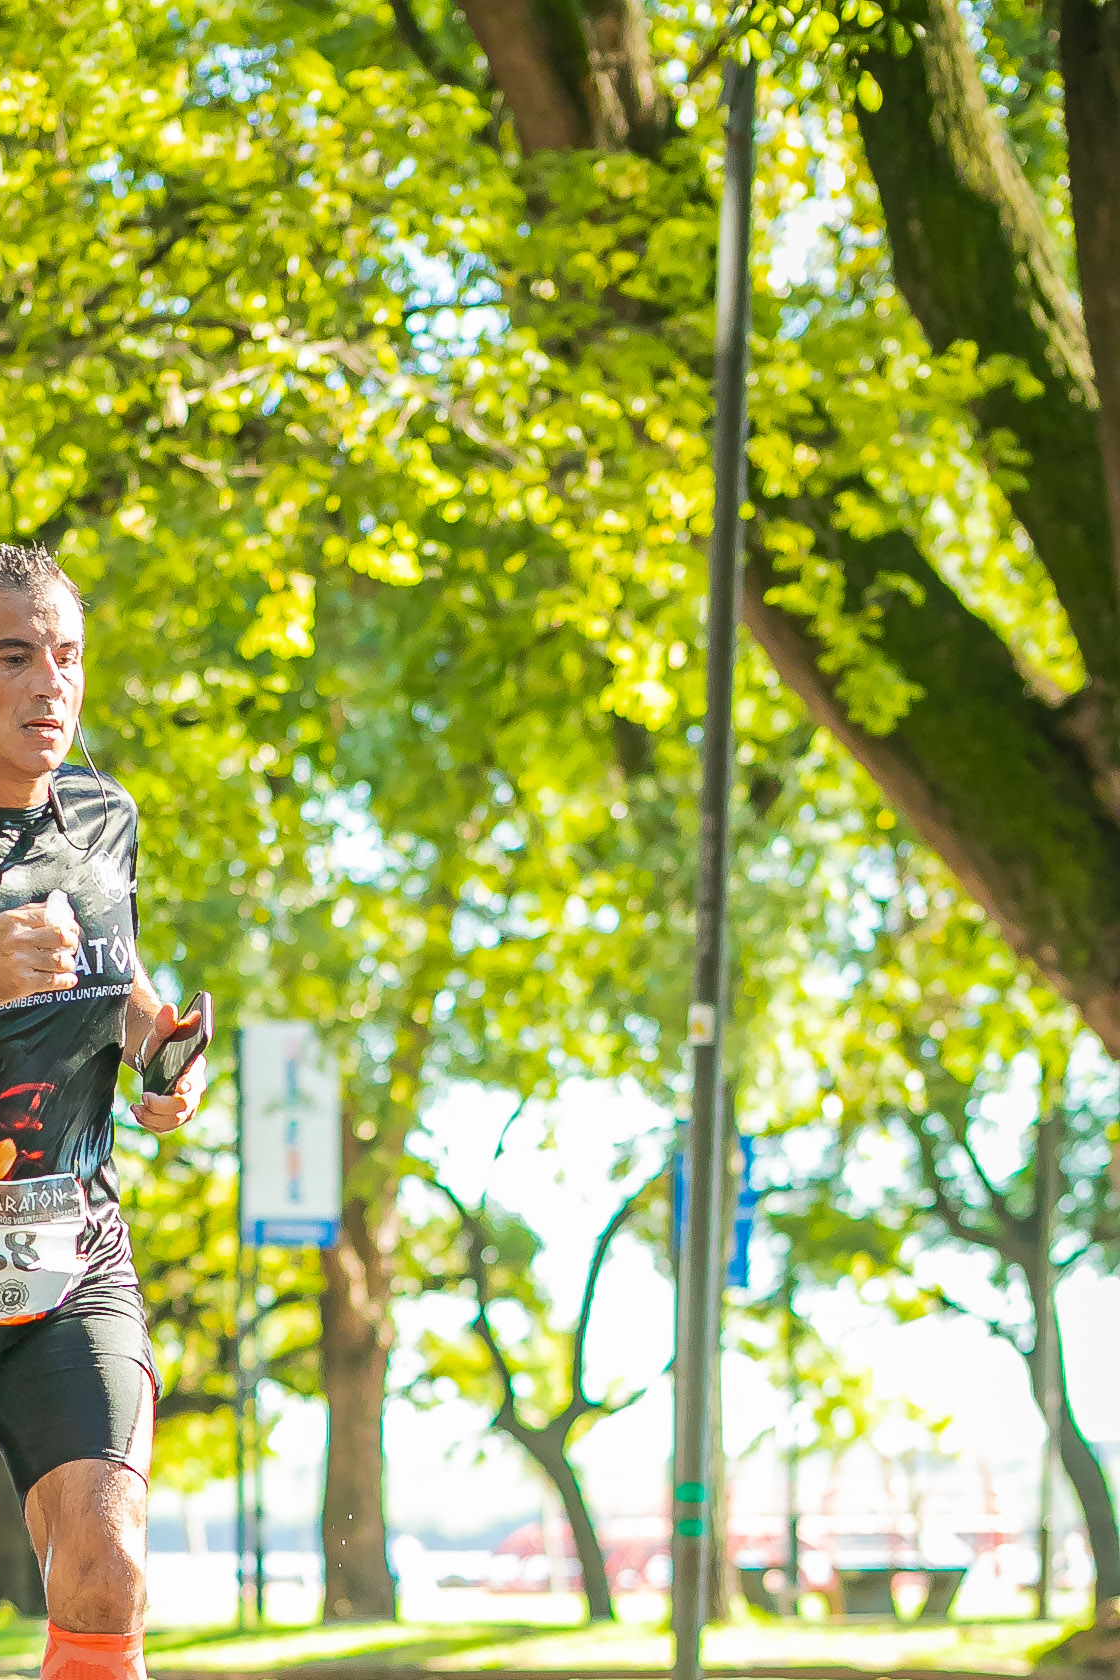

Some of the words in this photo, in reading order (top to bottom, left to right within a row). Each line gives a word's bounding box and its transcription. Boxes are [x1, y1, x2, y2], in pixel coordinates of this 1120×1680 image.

[74, 924, 135, 976] ATÓN
[55, 984, 123, 1002] VOLUNTARIOS
[4, 1290, 20, 1303] 27
